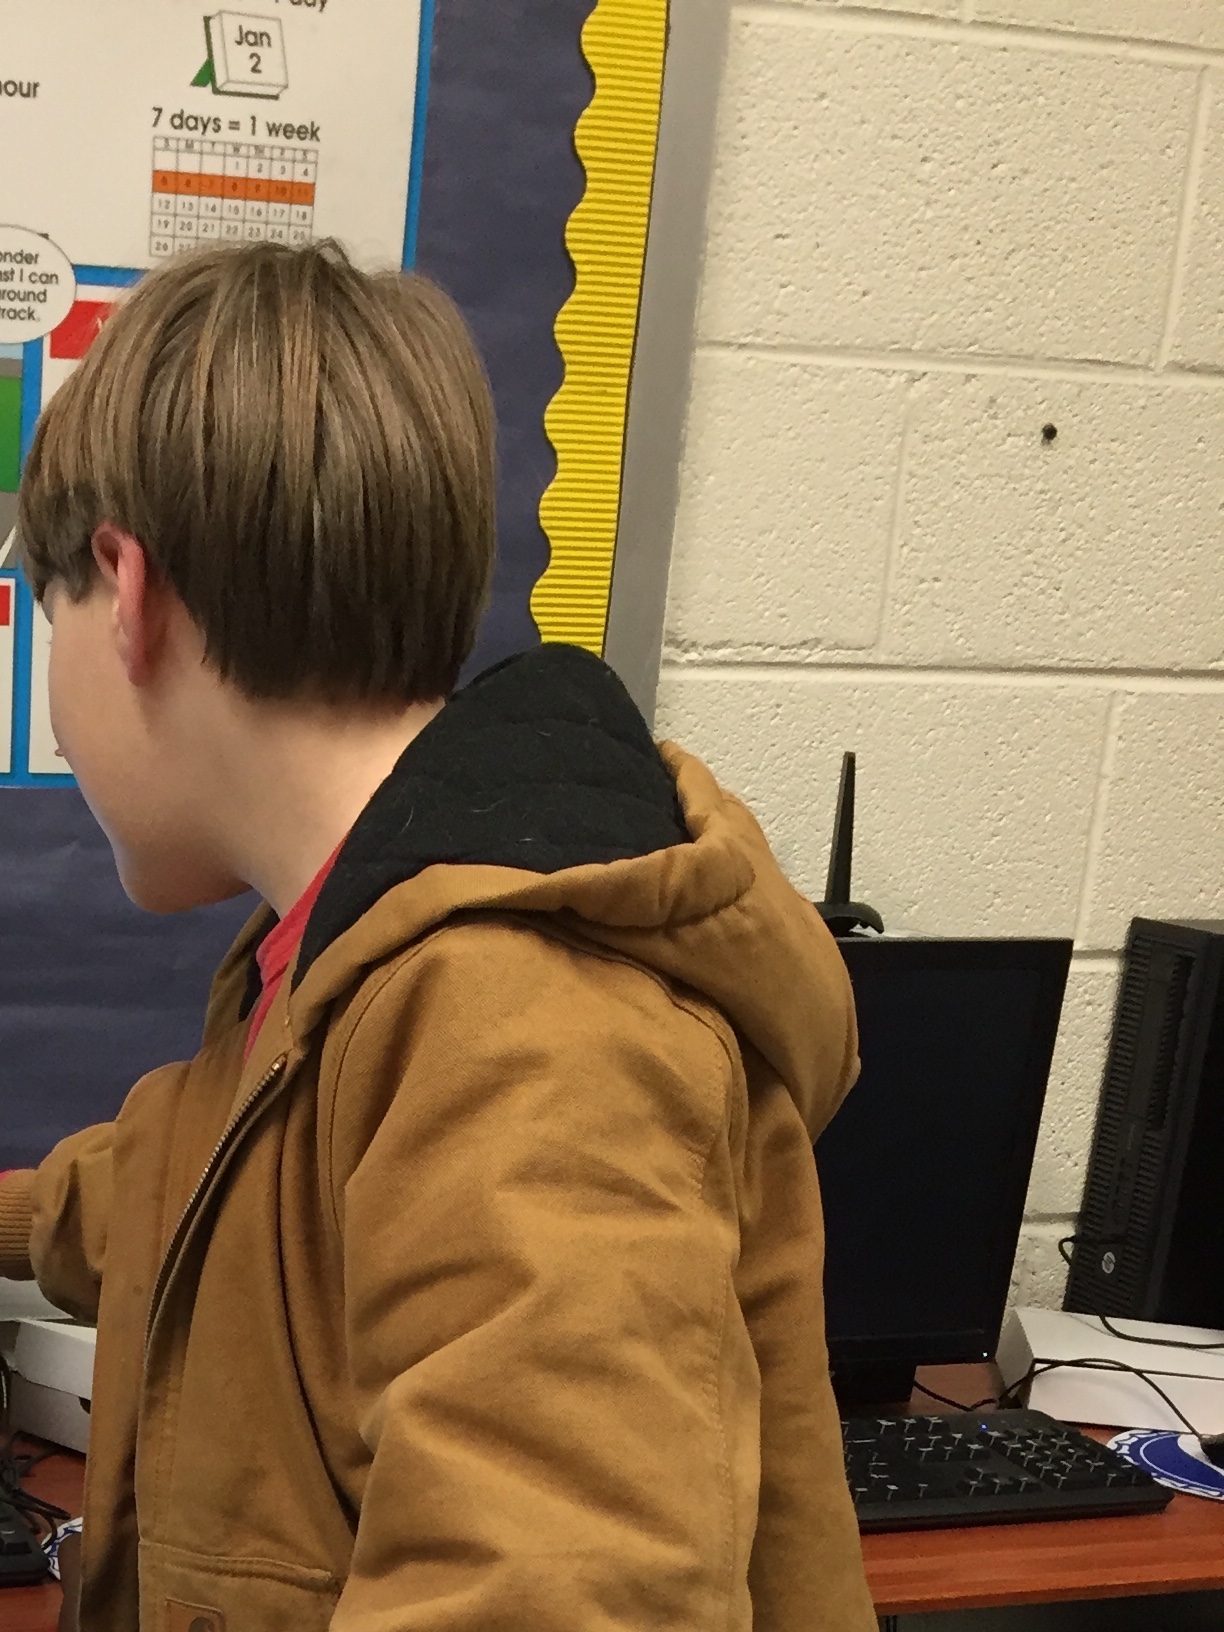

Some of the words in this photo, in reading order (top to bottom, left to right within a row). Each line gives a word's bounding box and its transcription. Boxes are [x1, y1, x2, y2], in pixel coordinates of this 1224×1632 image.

[235, 25, 271, 47] Jan
[249, 53, 262, 73] 2
[152, 107, 163, 127] 7
[170, 109, 221, 135] days
[251, 116, 256, 136] 1
[266, 121, 320, 142] week
[28, 272, 59, 284] can
